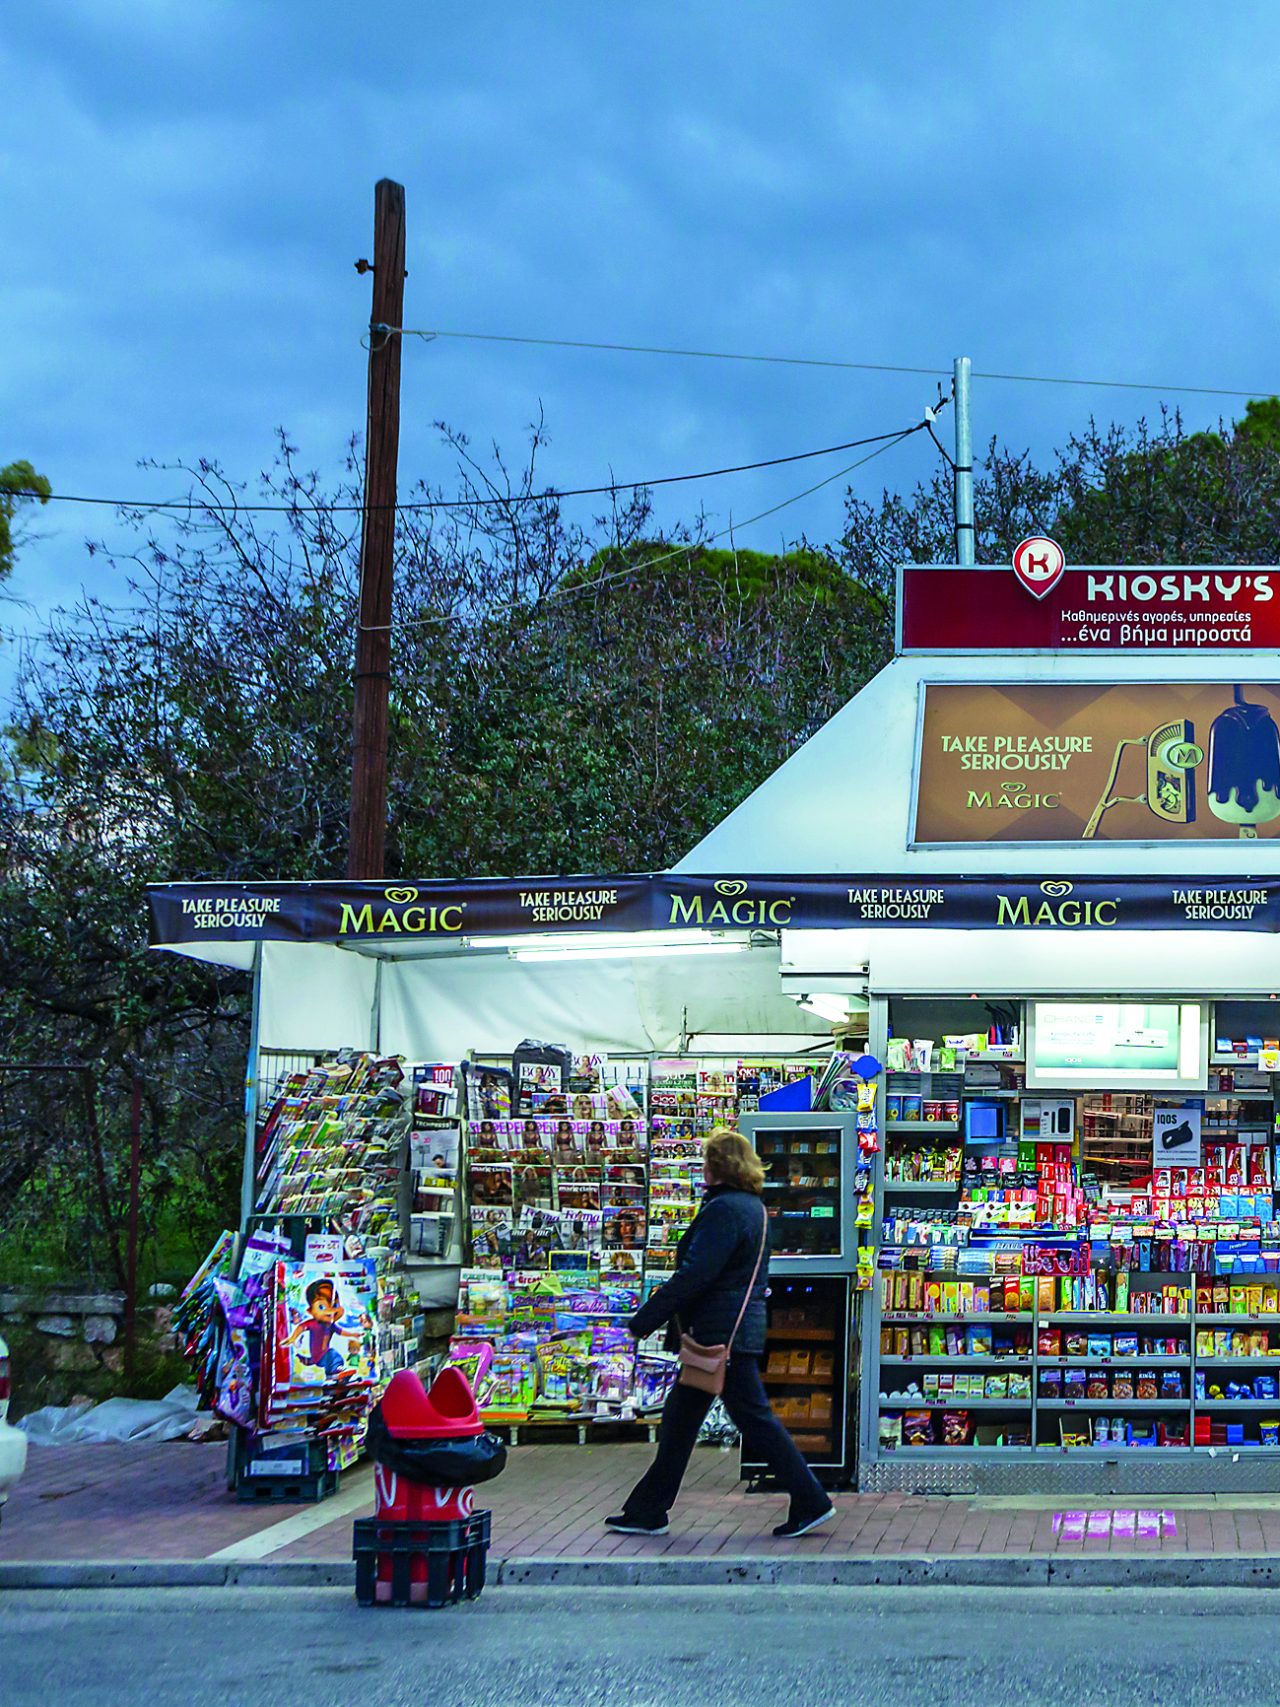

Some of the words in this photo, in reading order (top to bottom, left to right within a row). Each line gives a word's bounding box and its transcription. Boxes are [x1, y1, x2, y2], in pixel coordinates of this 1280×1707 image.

[1088, 575, 1274, 601] KIOSKY'S
[1061, 610, 1140, 623] Καθημερινές
[1142, 611, 1187, 624] αγορές,
[1189, 610, 1252, 623] υπηρεσίες
[1120, 624, 1168, 646] βήμα
[1173, 625, 1251, 646] μπροστά
[941, 736, 988, 753] TAKE
[994, 736, 1093, 754] PLEASURE
[960, 754, 1072, 771] SERIOUSLY
[966, 790, 1060, 809] MAGIC
[520, 892, 551, 908] TAKE
[553, 890, 617, 906] PLEASURE
[847, 889, 879, 904] TAKE
[881, 889, 944, 904] PLEASURE
[1173, 890, 1203, 905] TAKE
[1206, 889, 1268, 904] PLEASURE
[181, 899, 213, 915] TAKE
[215, 898, 280, 914] PLEASURE
[532, 904, 604, 923] SERIOUSLY
[670, 894, 786, 925] MAGIC
[860, 903, 931, 919] SERIOUSLY
[997, 895, 1113, 926] MAGIC
[1185, 903, 1254, 920] SERIOUSLY
[193, 911, 266, 929] SERIOUSLY
[339, 903, 463, 935] MAGIC
[434, 1069, 451, 1083] 100
[1157, 1114, 1177, 1125] IQOS
